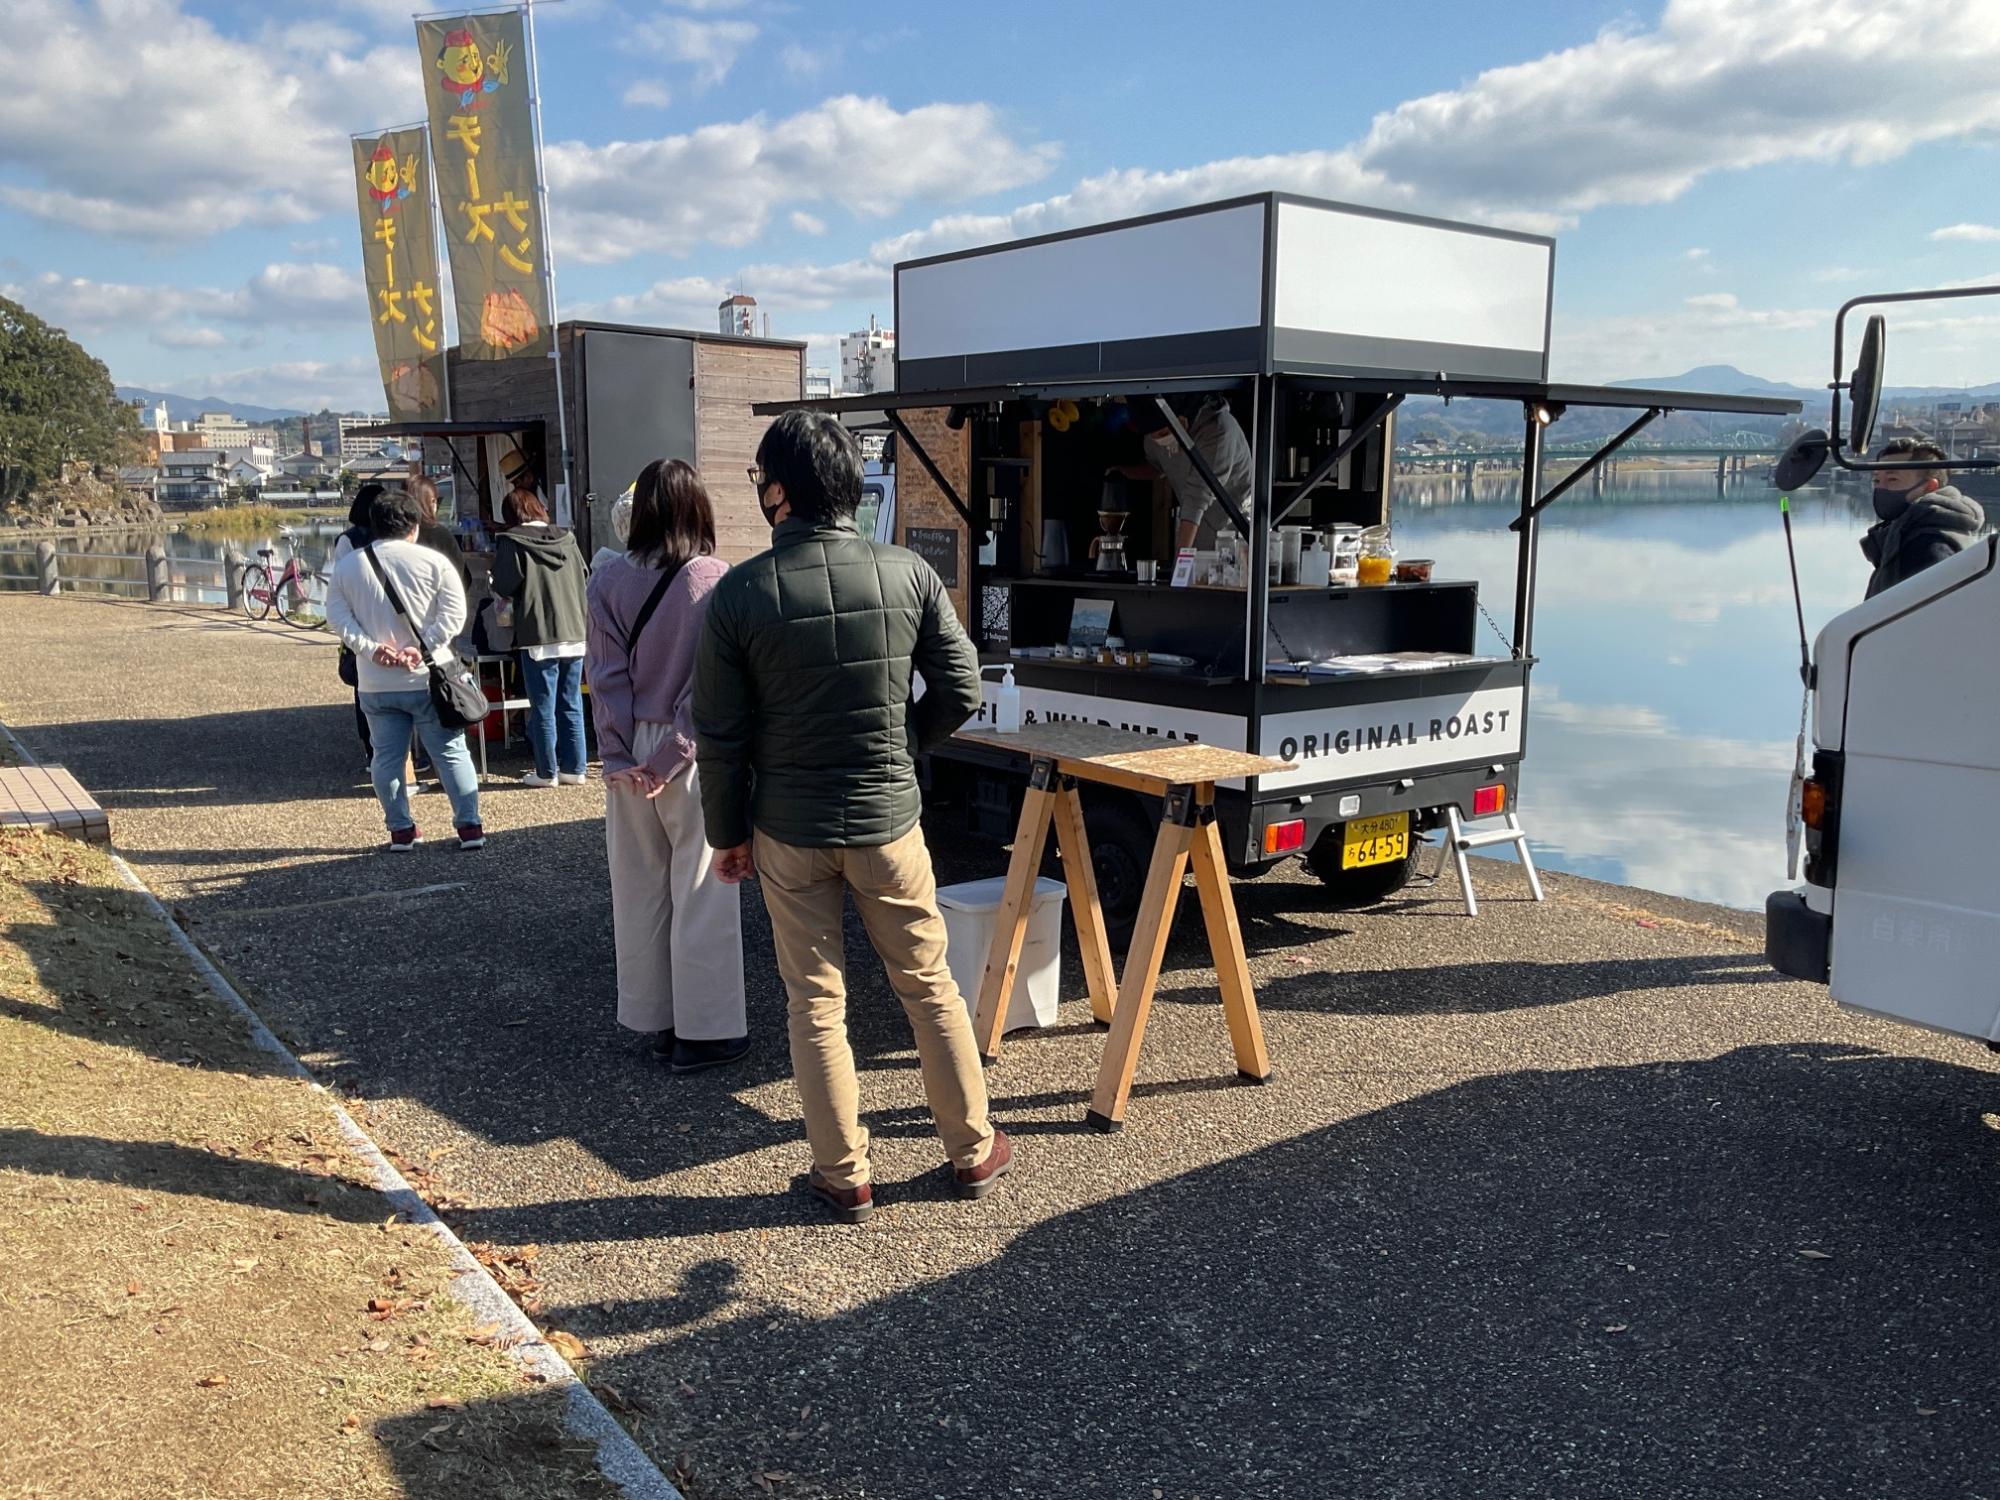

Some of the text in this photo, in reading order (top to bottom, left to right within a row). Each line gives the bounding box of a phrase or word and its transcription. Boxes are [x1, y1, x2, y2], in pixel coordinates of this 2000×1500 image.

[1279, 710, 1510, 762] ORIGINAL ROAST
[1358, 832, 1404, 862] 64-59
